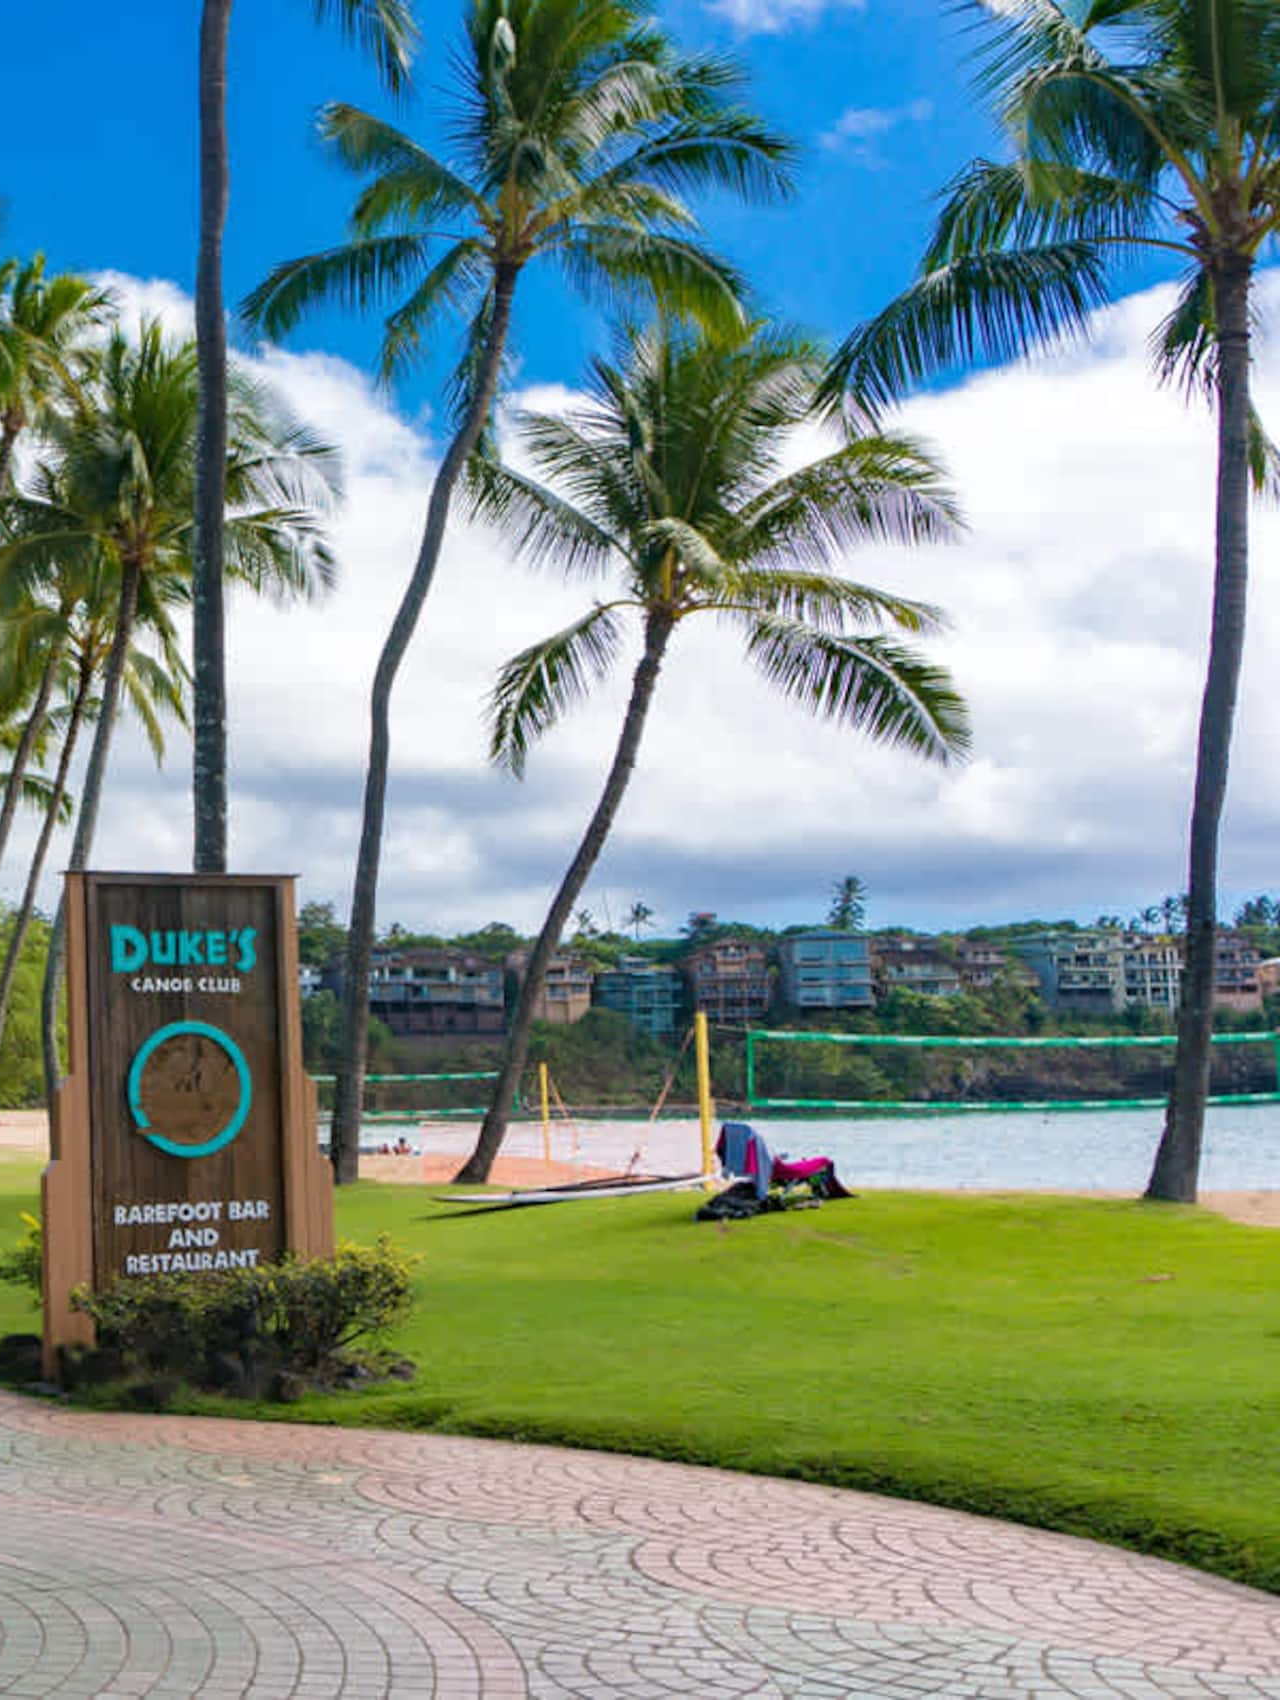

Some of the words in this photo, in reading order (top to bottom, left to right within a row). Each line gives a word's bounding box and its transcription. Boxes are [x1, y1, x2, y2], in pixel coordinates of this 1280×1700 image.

[109, 923, 258, 973] DUKE'S
[130, 978, 193, 993] CANOE
[197, 977, 241, 993] CLUB
[114, 1202, 224, 1225] BAREFOOT
[228, 1200, 270, 1220] BAR
[168, 1228, 220, 1248] AND
[126, 1249, 259, 1274] RESTAURANT
